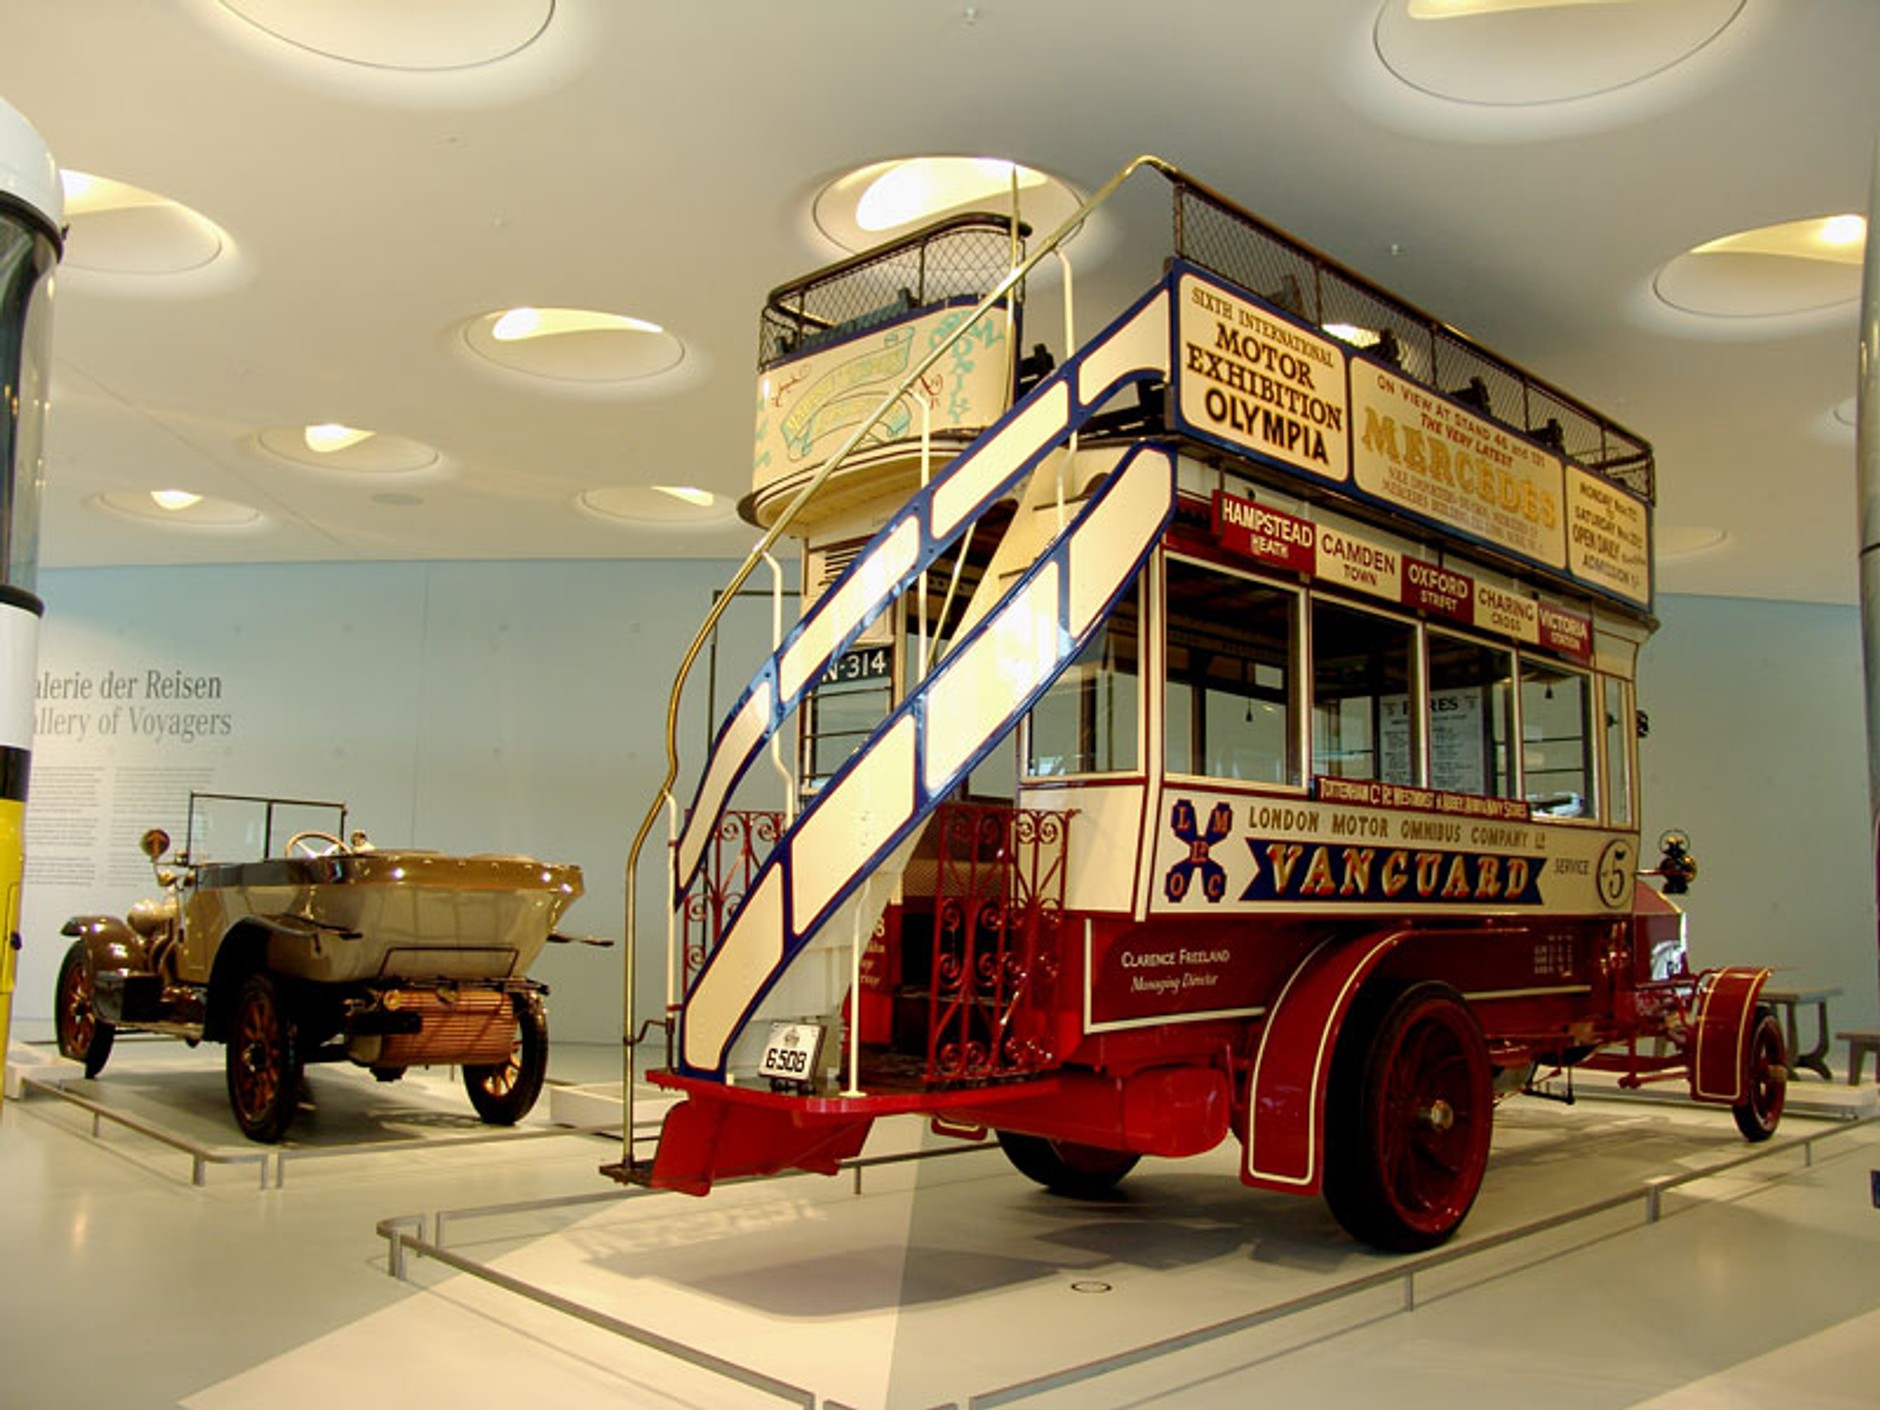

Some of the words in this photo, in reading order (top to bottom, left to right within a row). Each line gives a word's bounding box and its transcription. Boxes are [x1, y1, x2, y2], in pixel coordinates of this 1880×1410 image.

[1191, 286, 1233, 321] SIXTH
[1239, 307, 1334, 368] INTERNATIONAL
[1215, 322, 1315, 390] MOTOR
[1186, 341, 1343, 432] EXHIBITION
[1204, 386, 1329, 465] OLYMPIA
[1377, 374, 1396, 394] ON
[1400, 384, 1433, 410] VIEW
[1435, 403, 1451, 420] AT
[1454, 412, 1491, 441] STAND
[1420, 412, 1442, 434] THE
[1446, 425, 1474, 449] VERY
[1476, 440, 1513, 468] LATEST
[1222, 497, 1314, 549] HAMPSTEAD
[1250, 533, 1290, 559] HEATH
[1320, 532, 1396, 577] CAMDEN
[1343, 563, 1378, 587] TOWN
[1407, 563, 1469, 599] OXFORD
[1420, 589, 1459, 612] STREET
[1478, 586, 1536, 623] CHARING
[1491, 611, 1522, 632] CROSS
[36, 670, 93, 700] lerie
[99, 670, 139, 700] der
[144, 669, 223, 700] Reisen
[34, 706, 91, 743] llery
[98, 705, 123, 735] of
[128, 706, 233, 744] Voyagers
[1249, 805, 1320, 833] LONDON
[1332, 812, 1389, 839] MOTOR
[1400, 819, 1462, 844] OMNIBUS
[1470, 826, 1530, 848] COMPANY
[1265, 842, 1531, 899] VANGUARD
[1555, 857, 1590, 876] SERVICE
[1120, 950, 1176, 969] CLARENCE
[1130, 974, 1181, 996] Managing
[1182, 972, 1219, 989] Director
